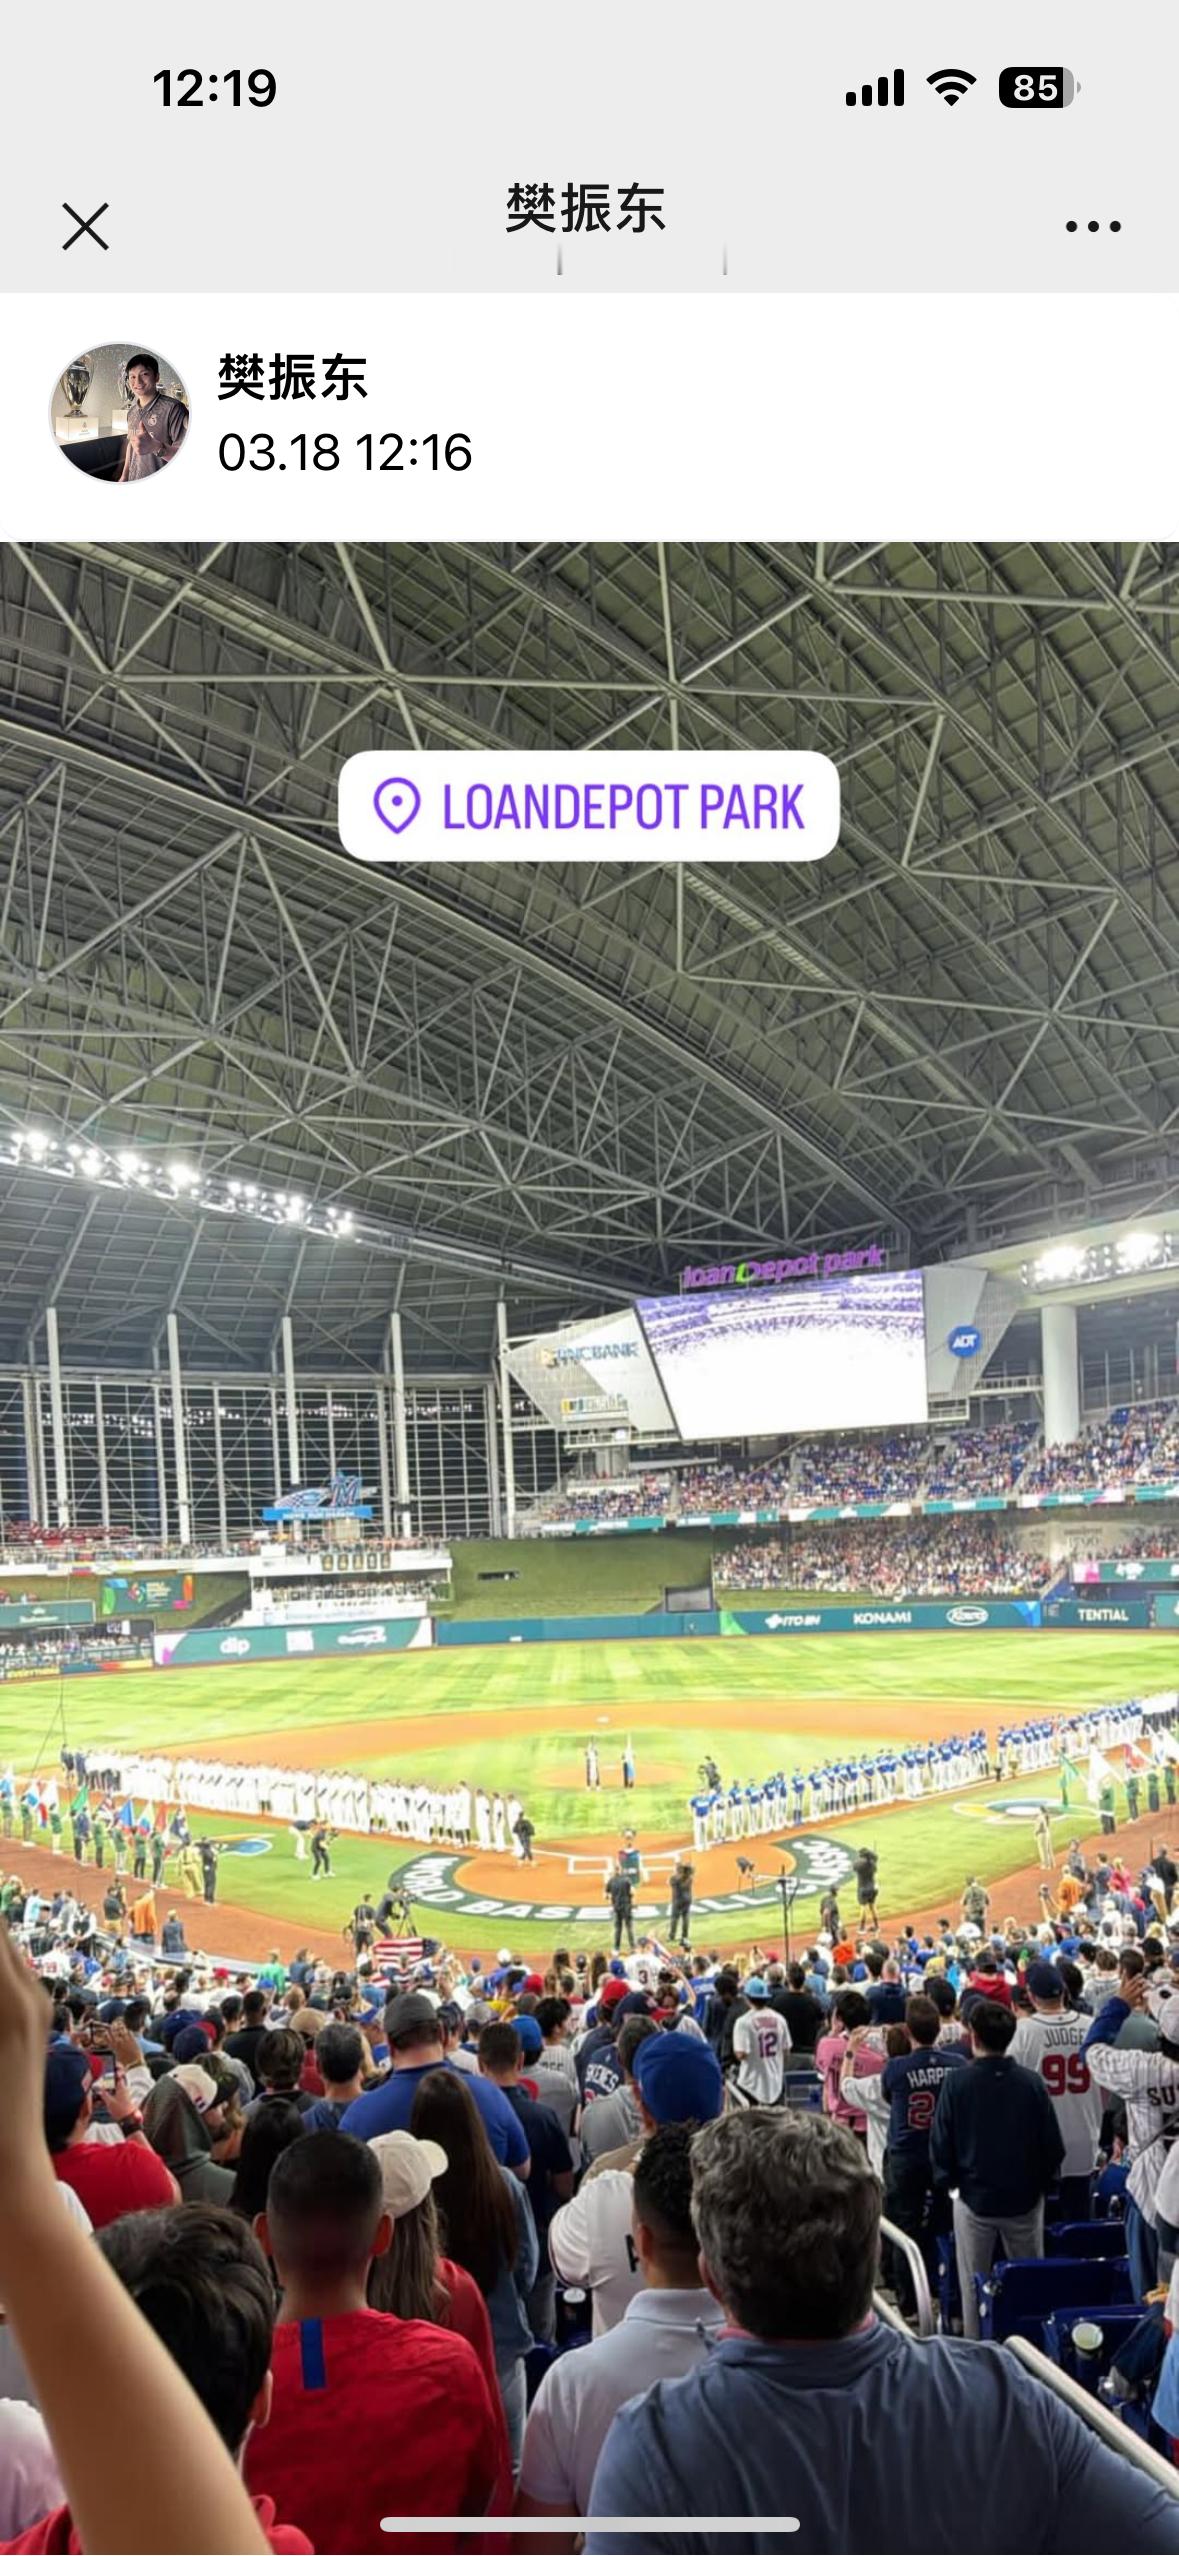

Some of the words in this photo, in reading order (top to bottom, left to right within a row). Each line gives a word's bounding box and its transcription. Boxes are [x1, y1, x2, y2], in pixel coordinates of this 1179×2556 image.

[823, 1244, 882, 1277] park
[952, 1333, 977, 1349] ADT
[853, 1611, 911, 1625] KONAMI
[1077, 1608, 1129, 1622] TENTIAL
[402, 1857, 464, 1903] WORLD
[638, 1969, 649, 1985] 3
[758, 2032, 777, 2058] 12
[1044, 2026, 1086, 2049] JUDGE
[906, 2066, 959, 2089] HARP
[1042, 2053, 1091, 2096] 99
[1147, 2085, 1179, 2106] SU
